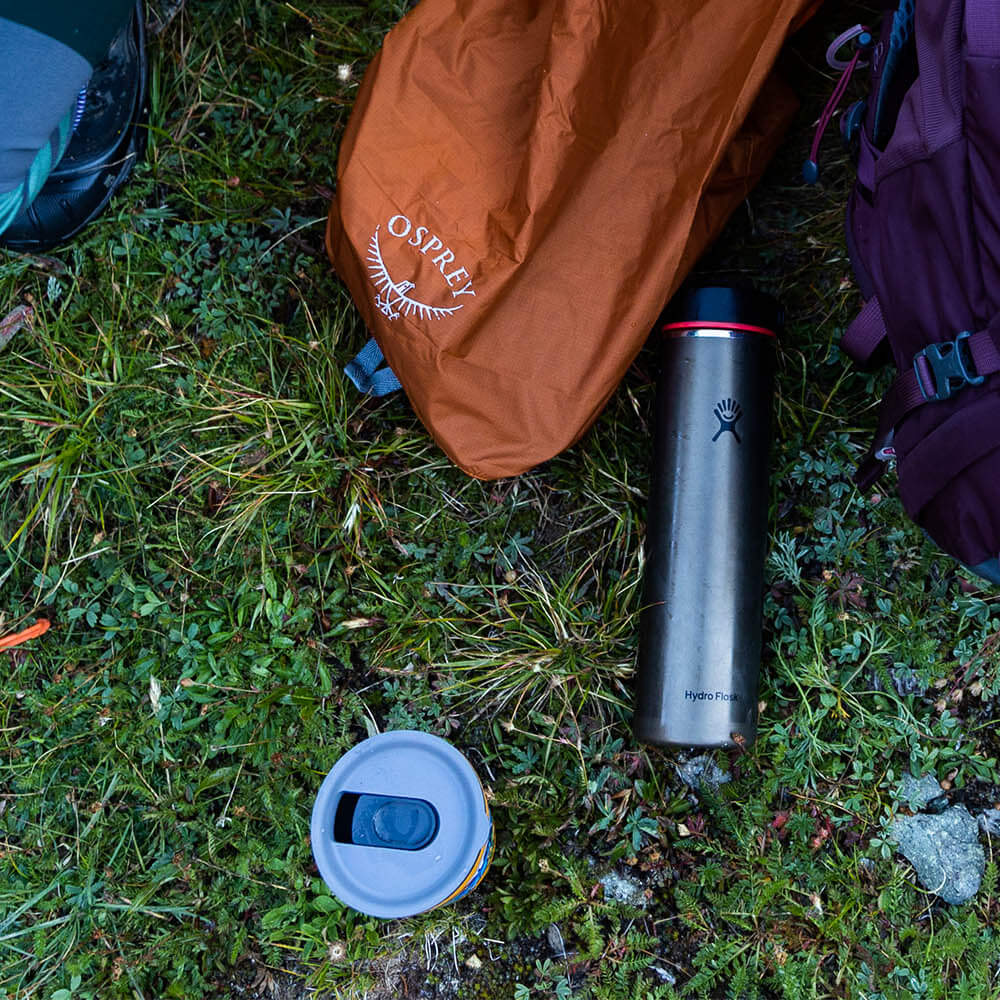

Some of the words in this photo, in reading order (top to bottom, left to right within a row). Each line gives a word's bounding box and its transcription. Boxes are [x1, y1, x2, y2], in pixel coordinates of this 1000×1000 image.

[387, 214, 477, 298] OSPREY
[684, 690, 714, 702] Hydro
[715, 691, 738, 702] Flask
